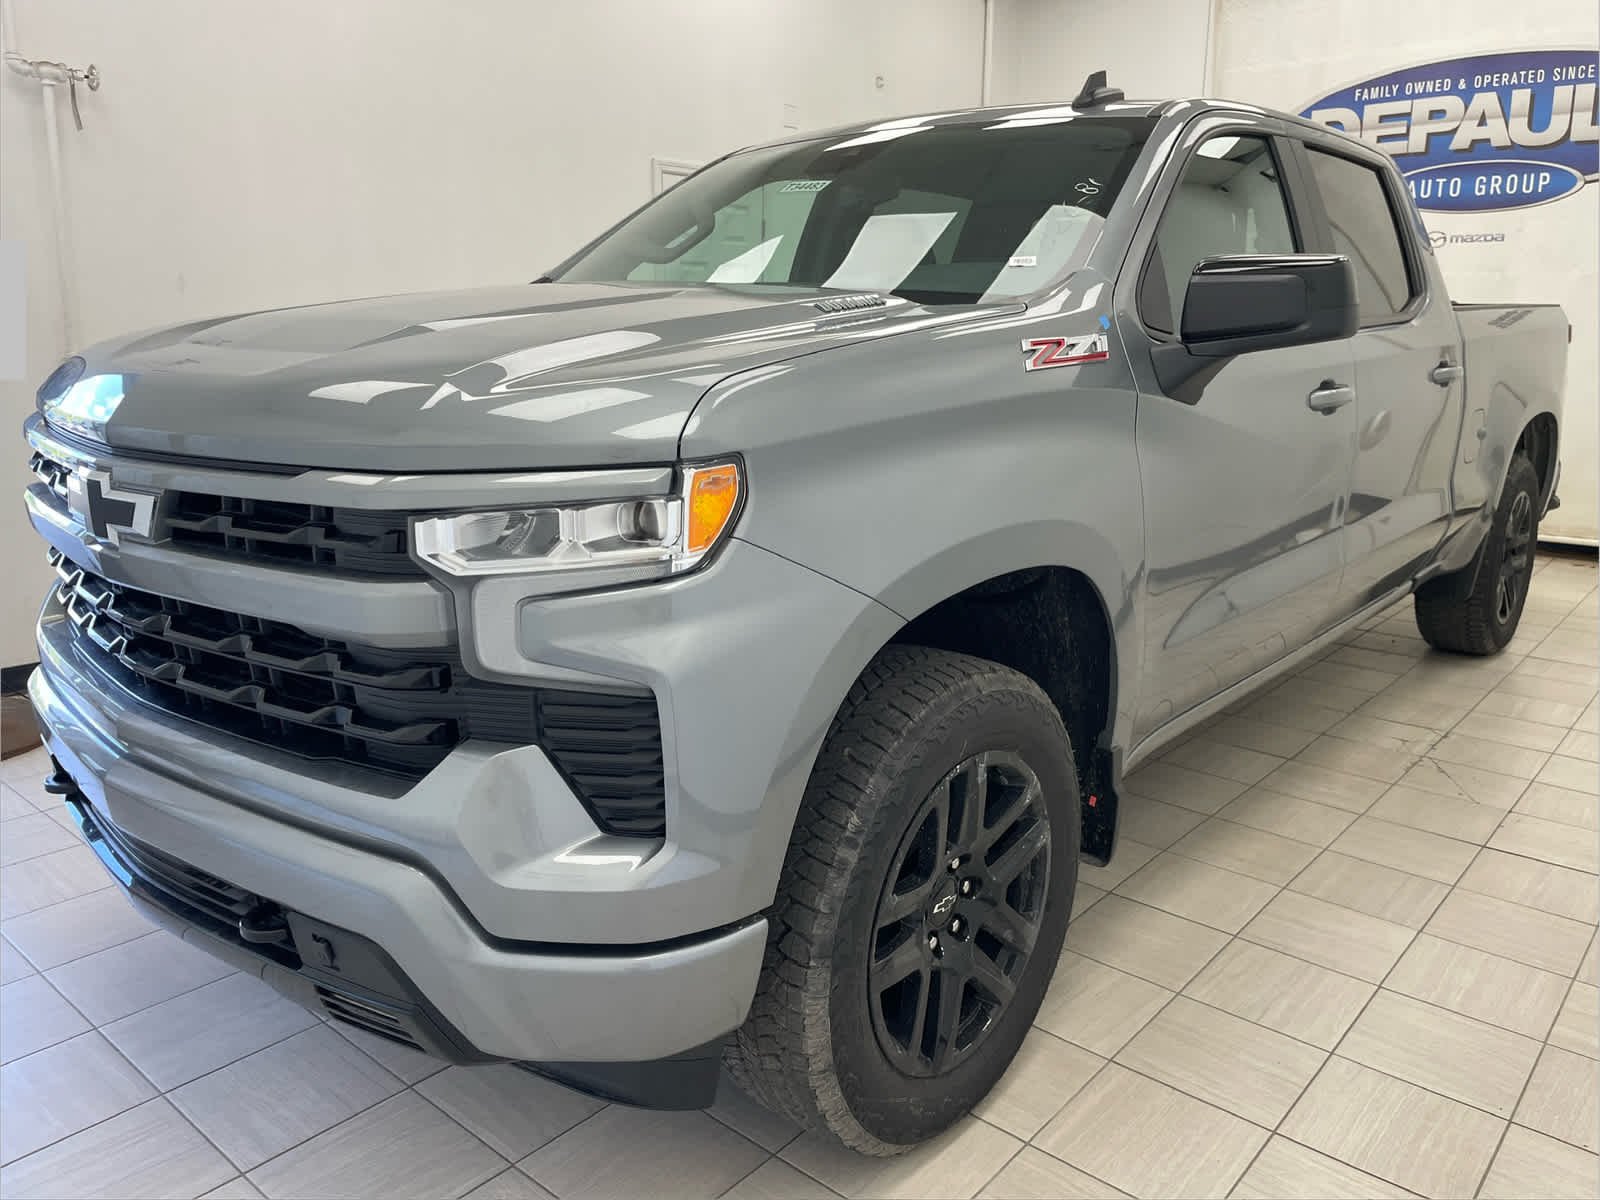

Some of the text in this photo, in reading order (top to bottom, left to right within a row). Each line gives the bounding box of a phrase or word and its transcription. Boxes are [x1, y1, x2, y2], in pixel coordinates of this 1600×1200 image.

[1354, 64, 1595, 102] FAMILY OWNED & OPERATED SINCE
[1474, 172, 1551, 196] GROUP
[1021, 334, 1109, 372] Z71
